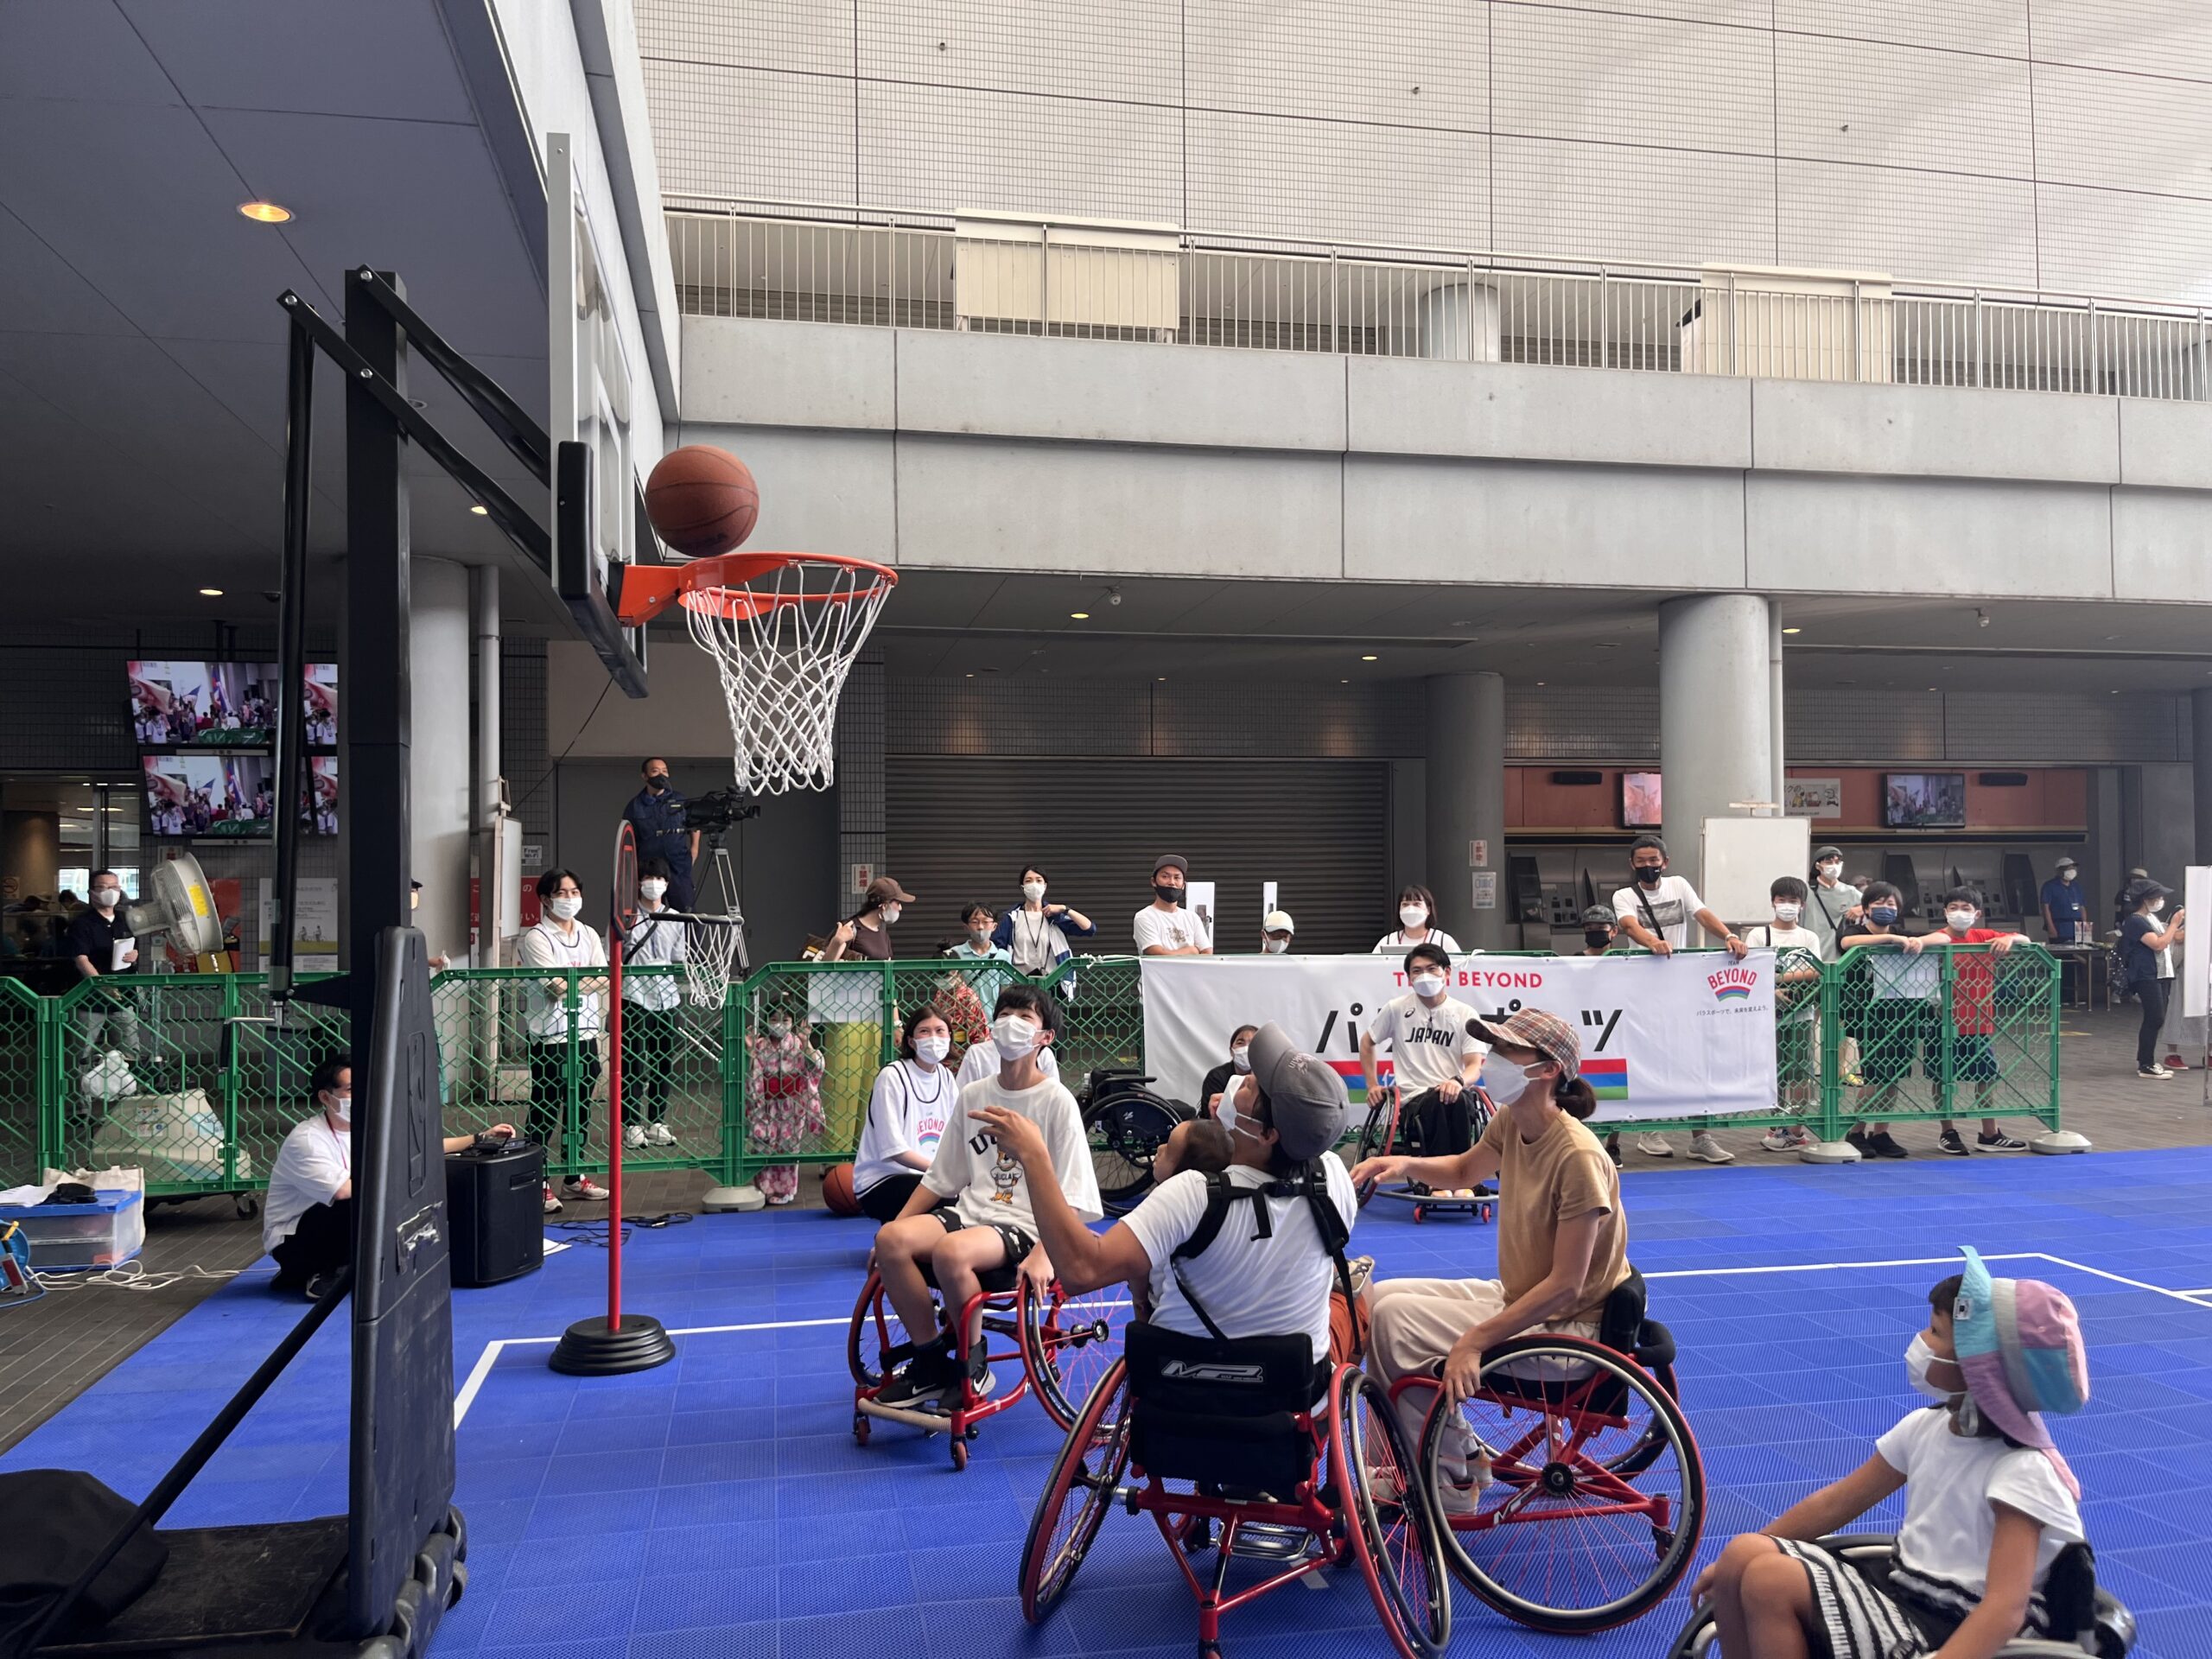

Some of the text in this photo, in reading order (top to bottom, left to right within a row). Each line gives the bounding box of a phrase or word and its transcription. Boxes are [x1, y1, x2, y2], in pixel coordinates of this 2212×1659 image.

[1459, 971, 1542, 988] BEYOND
[1707, 968, 1758, 989] BEYOND
[1405, 1027, 1454, 1047] JAPAN
